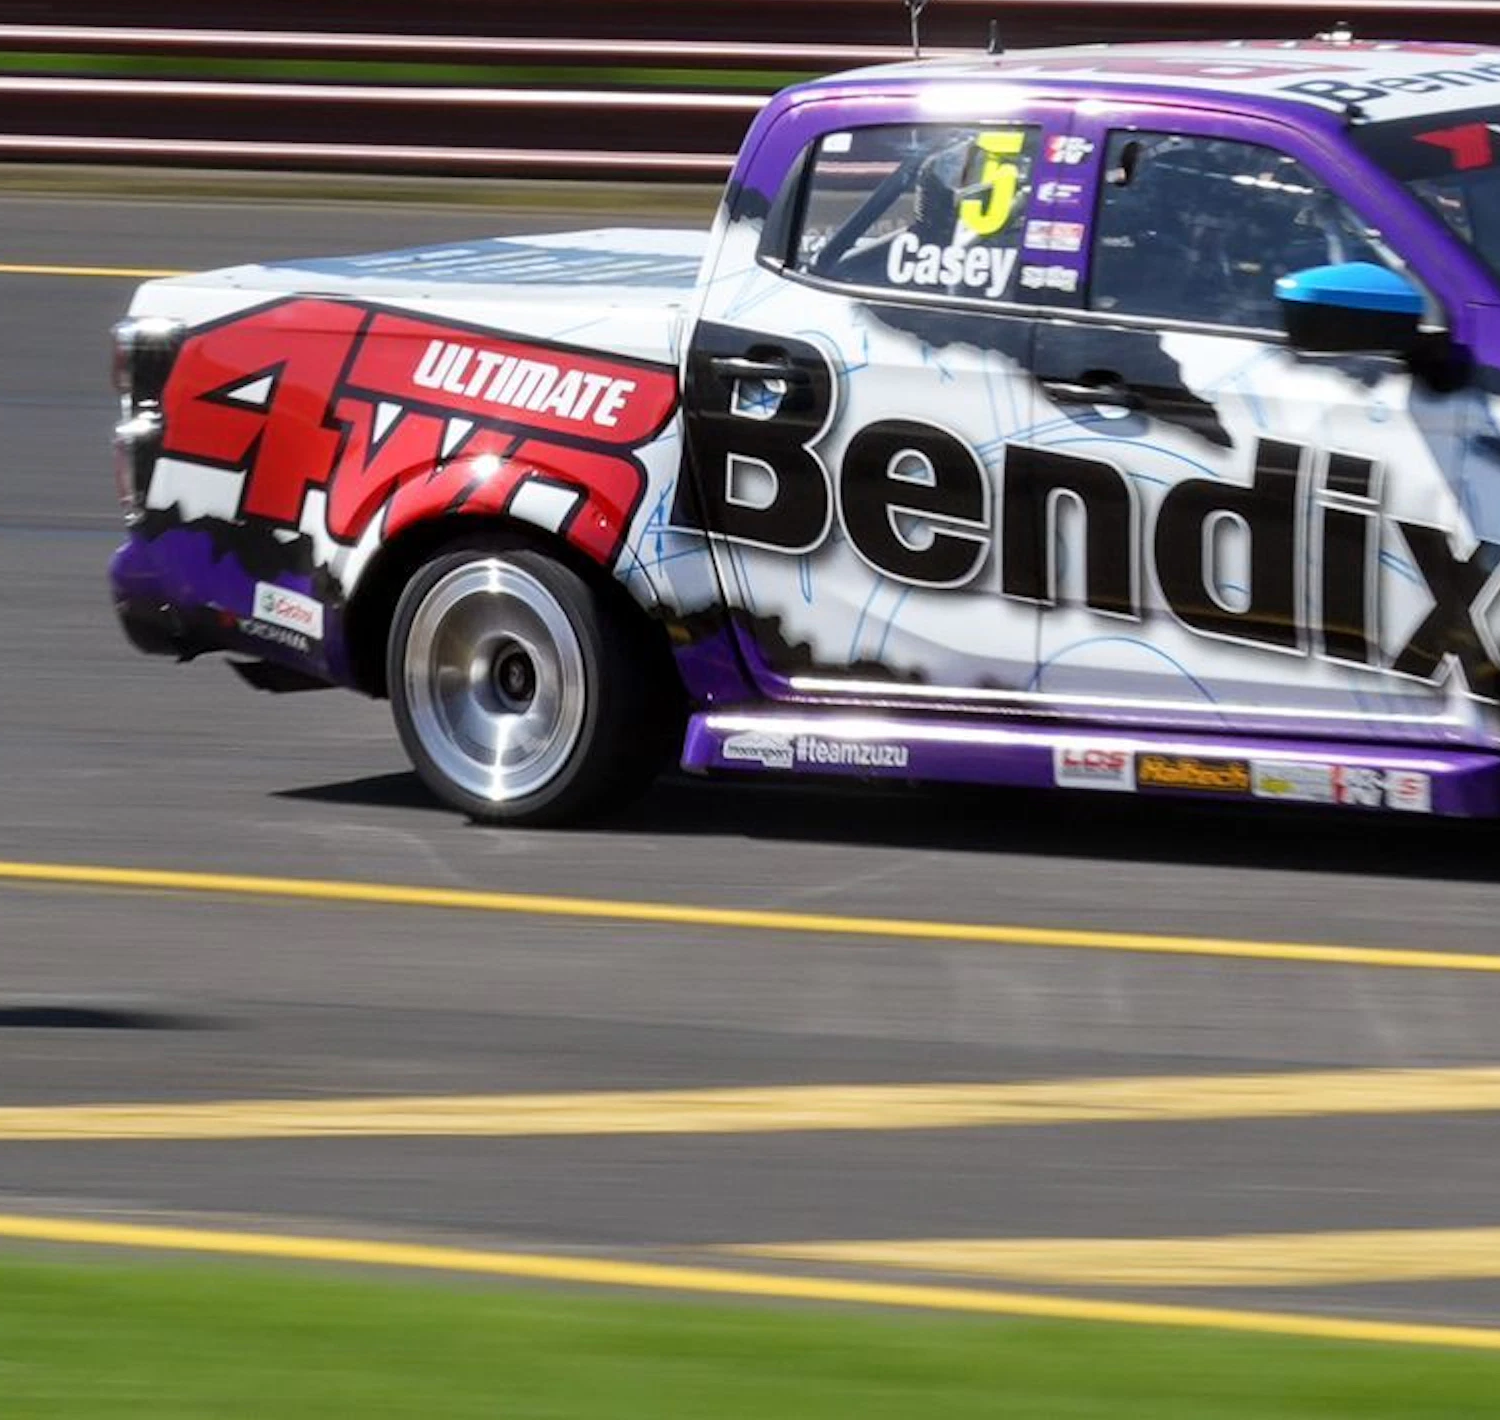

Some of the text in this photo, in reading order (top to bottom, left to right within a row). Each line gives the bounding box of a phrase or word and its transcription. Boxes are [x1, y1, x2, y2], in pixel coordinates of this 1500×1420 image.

[959, 131, 1026, 235] 5
[886, 231, 1018, 298] Casey
[411, 338, 636, 427] ULTIMATE
[796, 735, 908, 767] #teamzuzu
